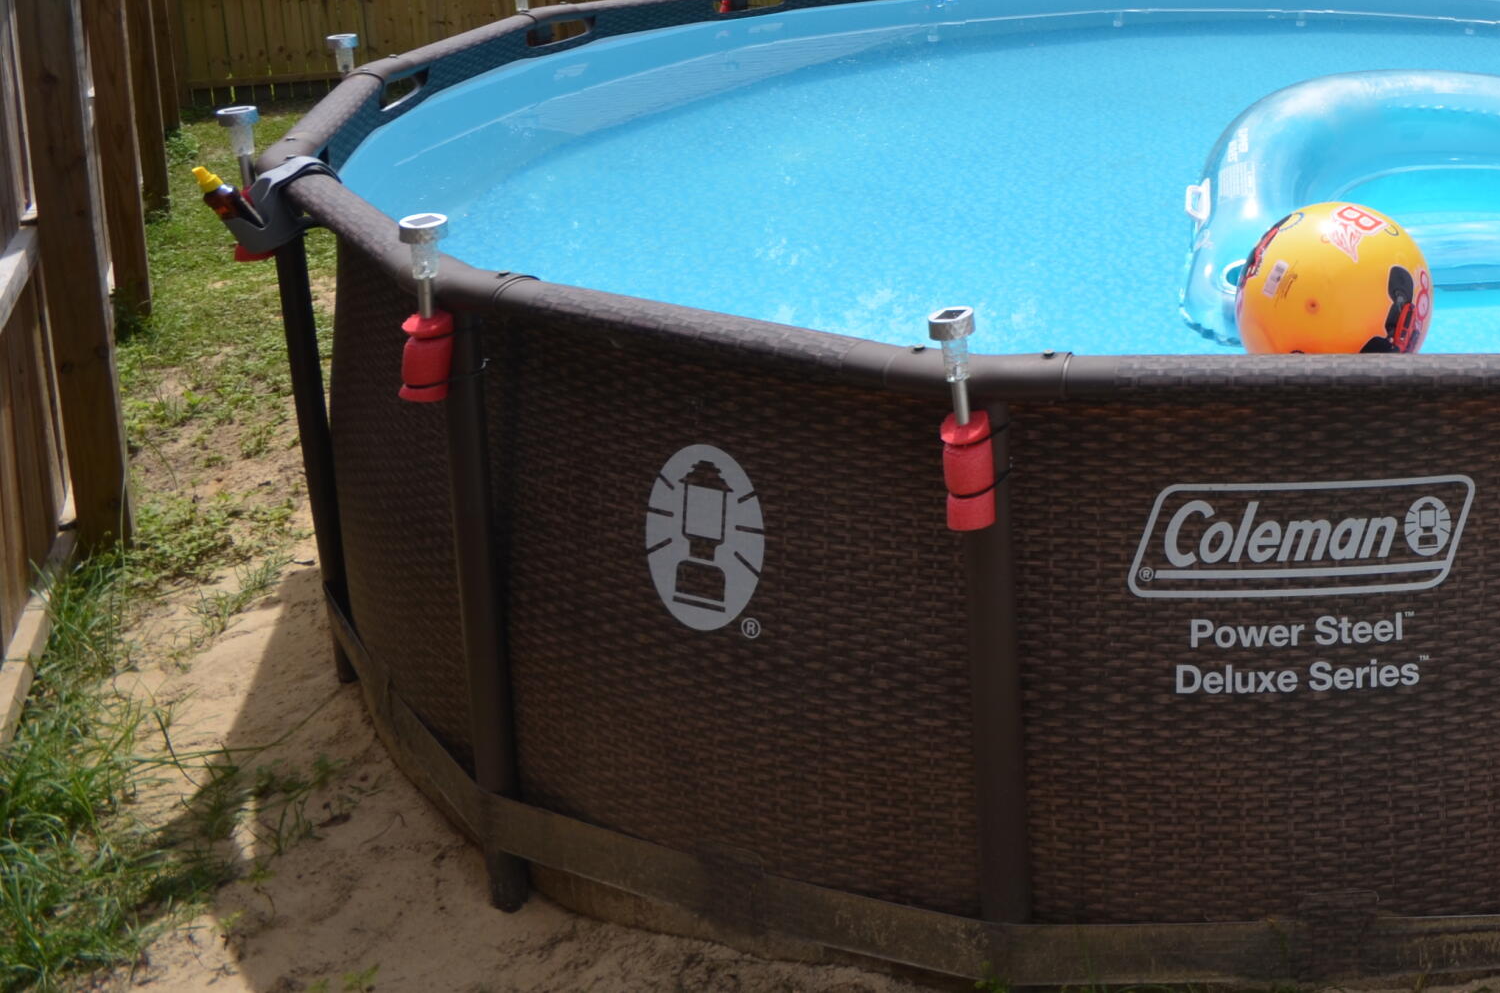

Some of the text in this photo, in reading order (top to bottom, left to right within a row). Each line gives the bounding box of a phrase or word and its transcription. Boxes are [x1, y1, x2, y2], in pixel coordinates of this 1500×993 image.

[1164, 500, 1397, 568] Coleman
[1190, 618, 1304, 648] Power
[1176, 664, 1298, 694] Deluxe
